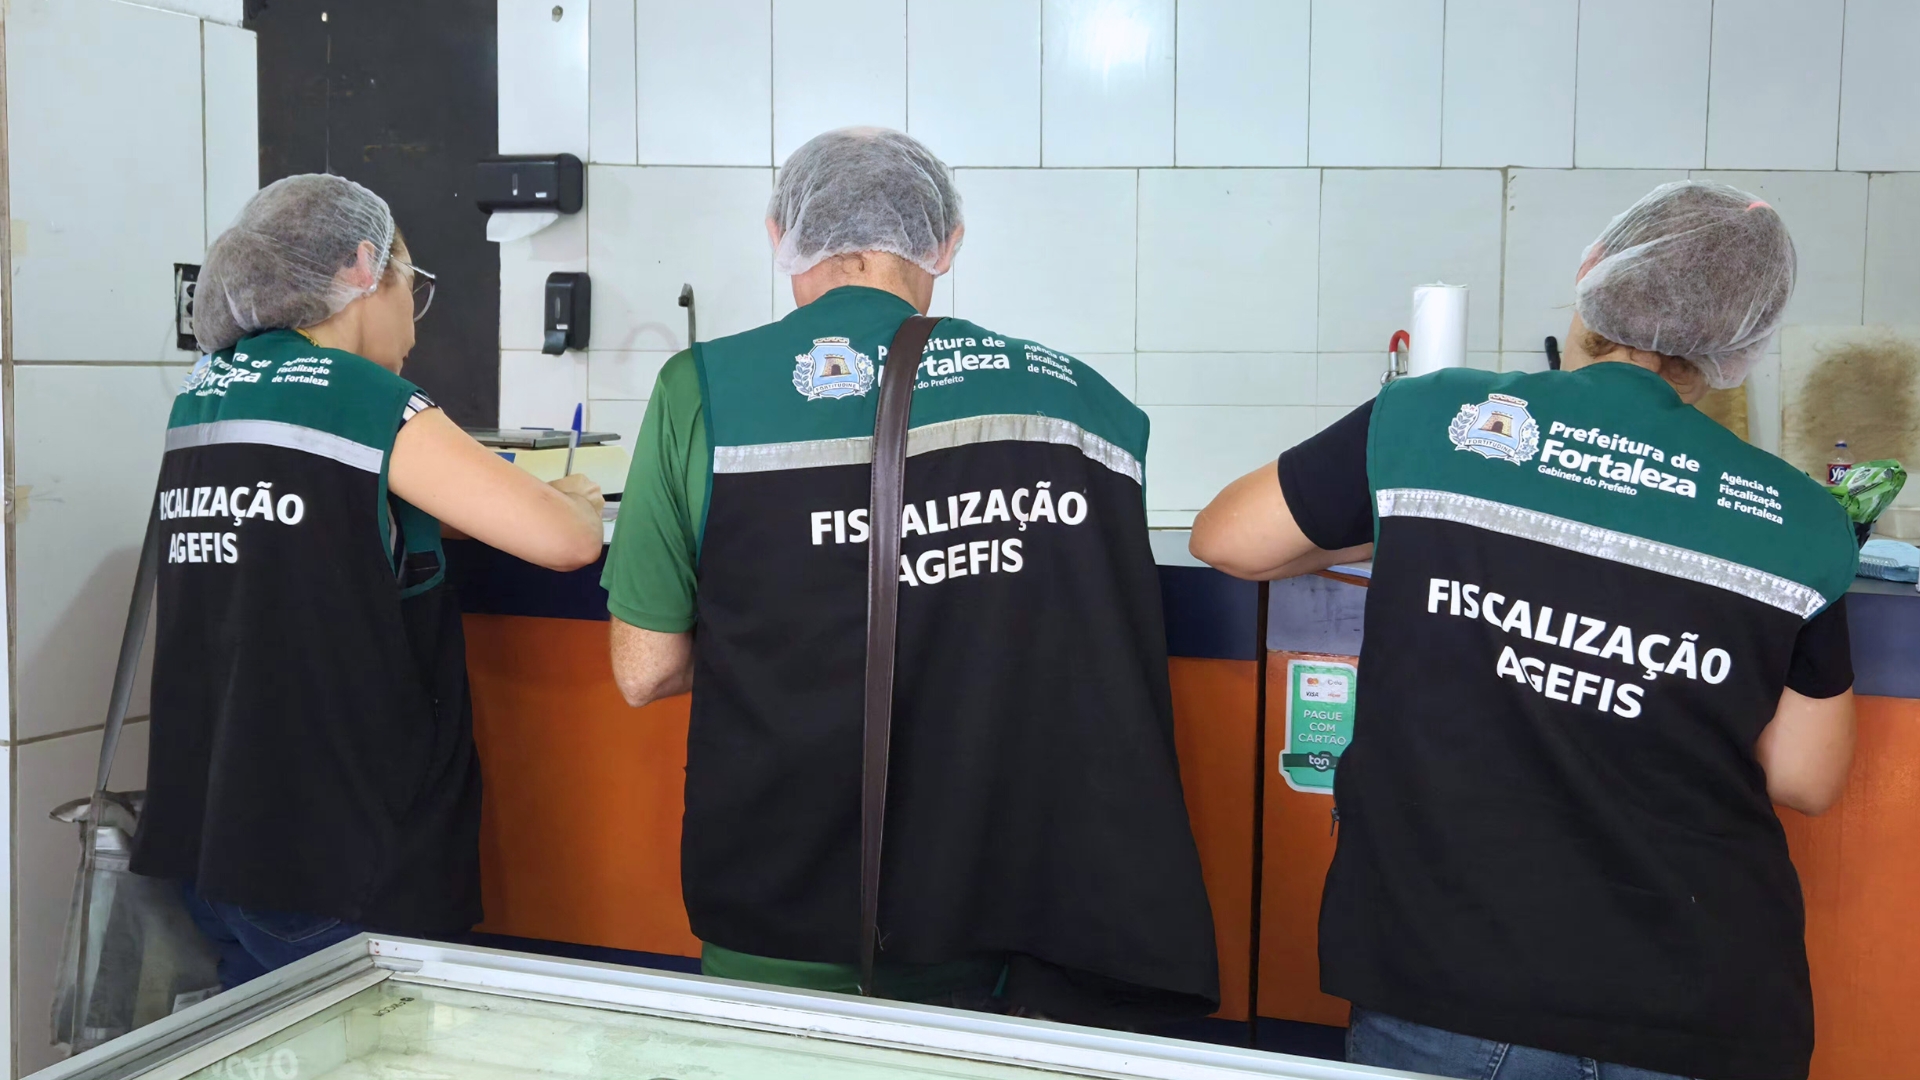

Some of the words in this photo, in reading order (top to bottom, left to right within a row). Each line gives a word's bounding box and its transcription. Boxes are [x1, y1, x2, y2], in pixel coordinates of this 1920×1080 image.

[981, 337, 1006, 348] de
[277, 365, 330, 376] Fiscalização
[319, 358, 333, 366] de
[877, 352, 1011, 388] rtaleza
[1058, 355, 1070, 363] de
[271, 375, 285, 384] de
[284, 375, 329, 387] Fortaleza
[917, 380, 930, 390] do
[930, 375, 964, 388] Prefeito
[1027, 363, 1040, 373] de
[1041, 365, 1078, 387] Fortaleza
[1468, 439, 1513, 454] FORTITUDINE
[1549, 421, 1665, 464] Prefeitura
[1670, 454, 1700, 473] de
[1537, 464, 1582, 486] Gabinete
[1583, 475, 1597, 487] do
[1597, 479, 1638, 496] Prefeito
[1540, 438, 1697, 499] Fortaleza
[1720, 471, 1765, 492] Agência
[1766, 484, 1779, 497] de
[159, 481, 305, 526] ISCALIZAÇÃO
[1719, 483, 1782, 511] Fiscalização
[810, 480, 1088, 546] FISALIZAÇÃO
[1717, 497, 1731, 508] de
[1734, 501, 1784, 526] Fortaleza
[168, 532, 239, 564] AGEFIS
[1427, 578, 1732, 685] FISCALIZAÇÃO
[1496, 645, 1645, 719] AGEFIS
[1303, 709, 1343, 721] PAGUE
[1309, 722, 1336, 732] COM
[1298, 733, 1347, 745] CARTÃO
[1308, 755, 1329, 766] ton
